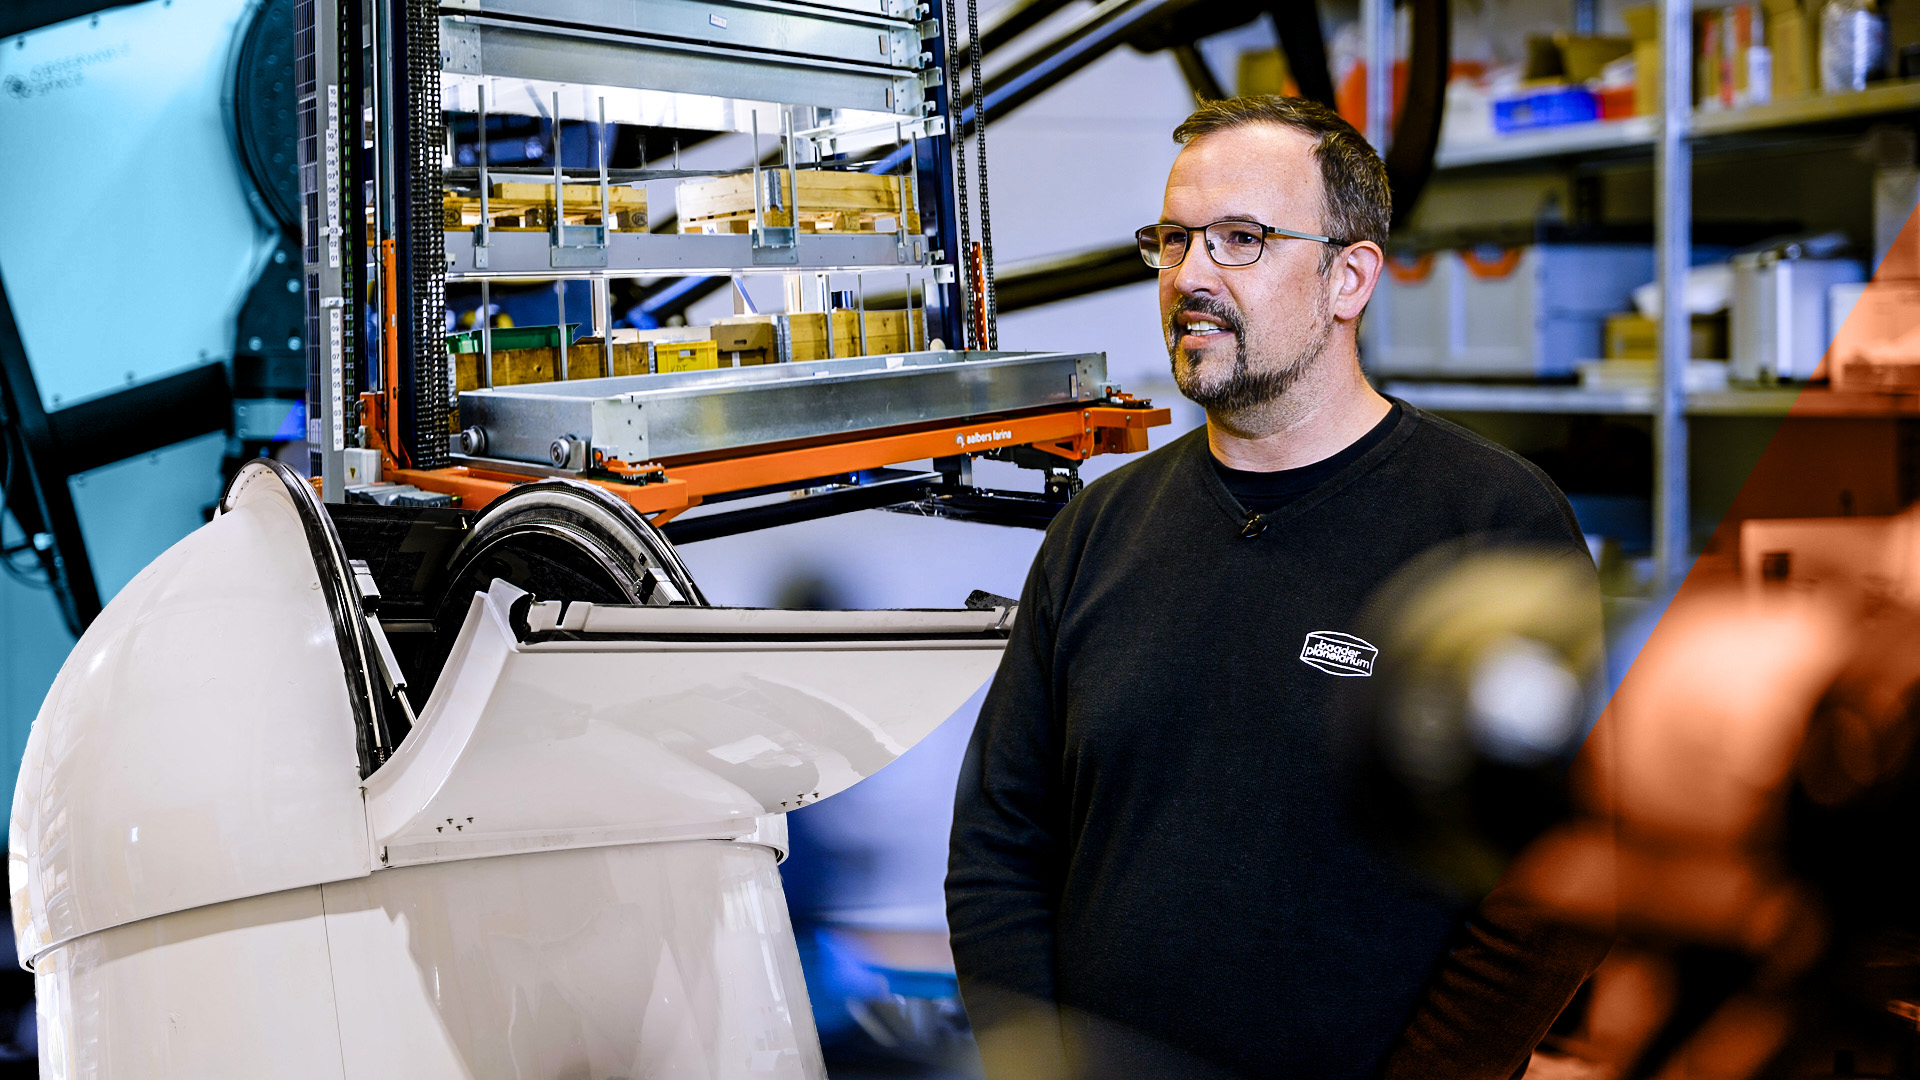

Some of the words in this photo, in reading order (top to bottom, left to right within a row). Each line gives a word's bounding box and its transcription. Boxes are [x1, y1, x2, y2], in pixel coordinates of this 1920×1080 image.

[966, 432, 992, 444] aalbers
[992, 428, 1012, 440] farina
[1304, 646, 1370, 669] planetarium
[1320, 640, 1362, 658] baader
